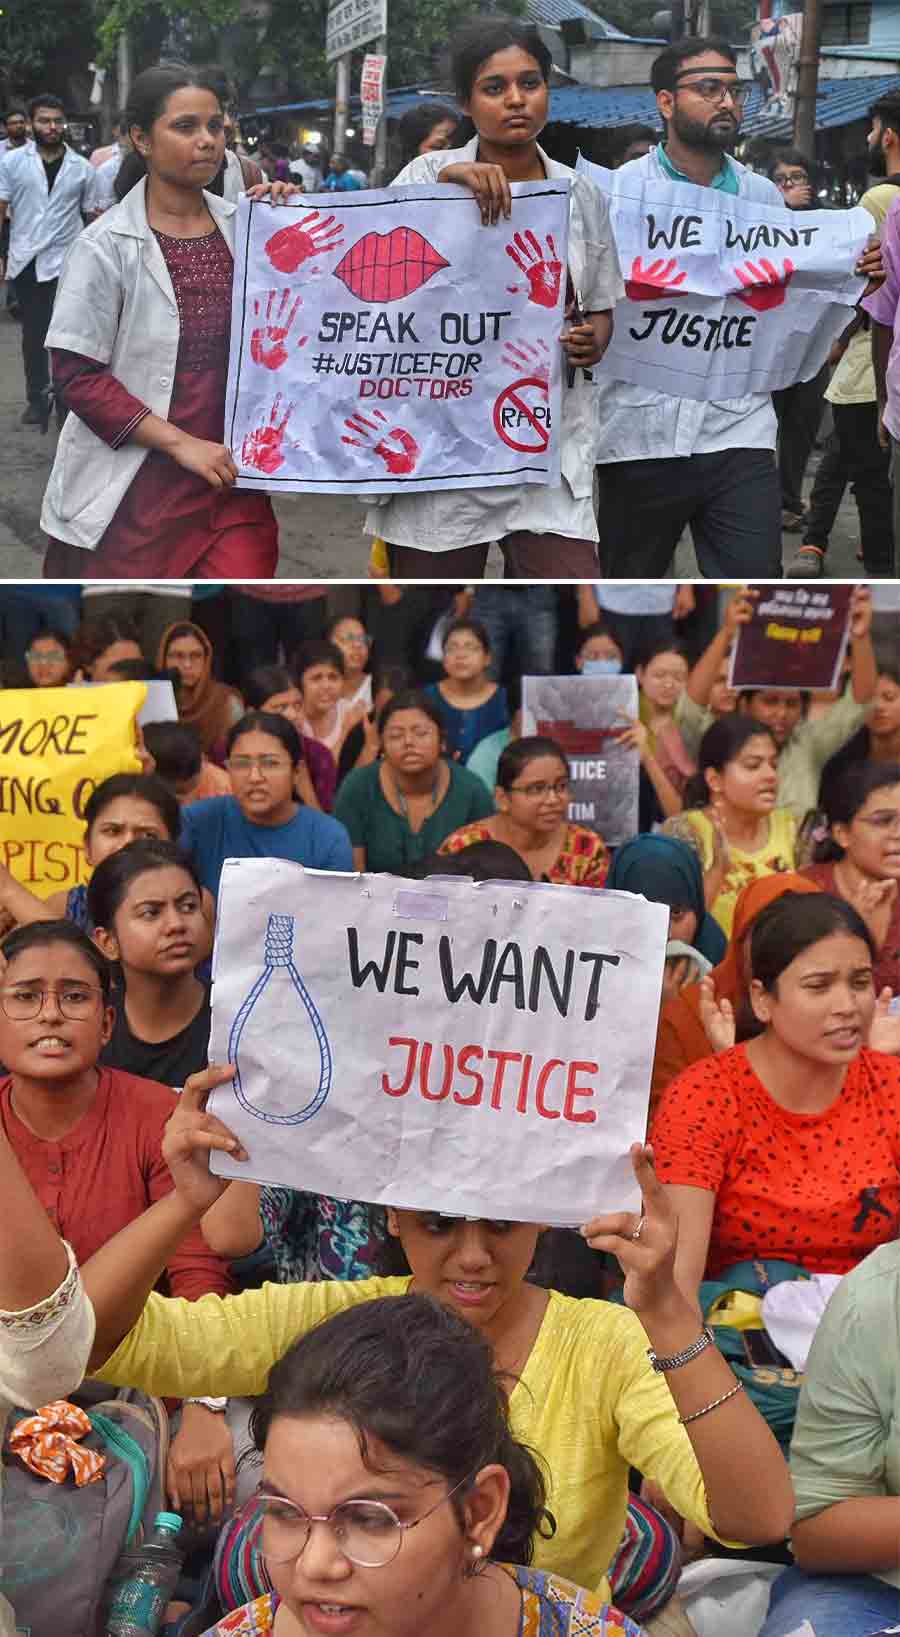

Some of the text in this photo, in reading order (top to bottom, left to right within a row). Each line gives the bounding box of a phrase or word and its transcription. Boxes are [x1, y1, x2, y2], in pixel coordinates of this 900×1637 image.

[646, 214, 819, 253] WE WANT
[317, 311, 512, 345] SPEAK OUT
[629, 308, 756, 351] JUSTICE
[312, 351, 483, 378] #JUSTICEFOR
[359, 377, 474, 400] DOCTORS
[346, 926, 621, 1022] WE WANT
[382, 1036, 599, 1124] JUSTICE
